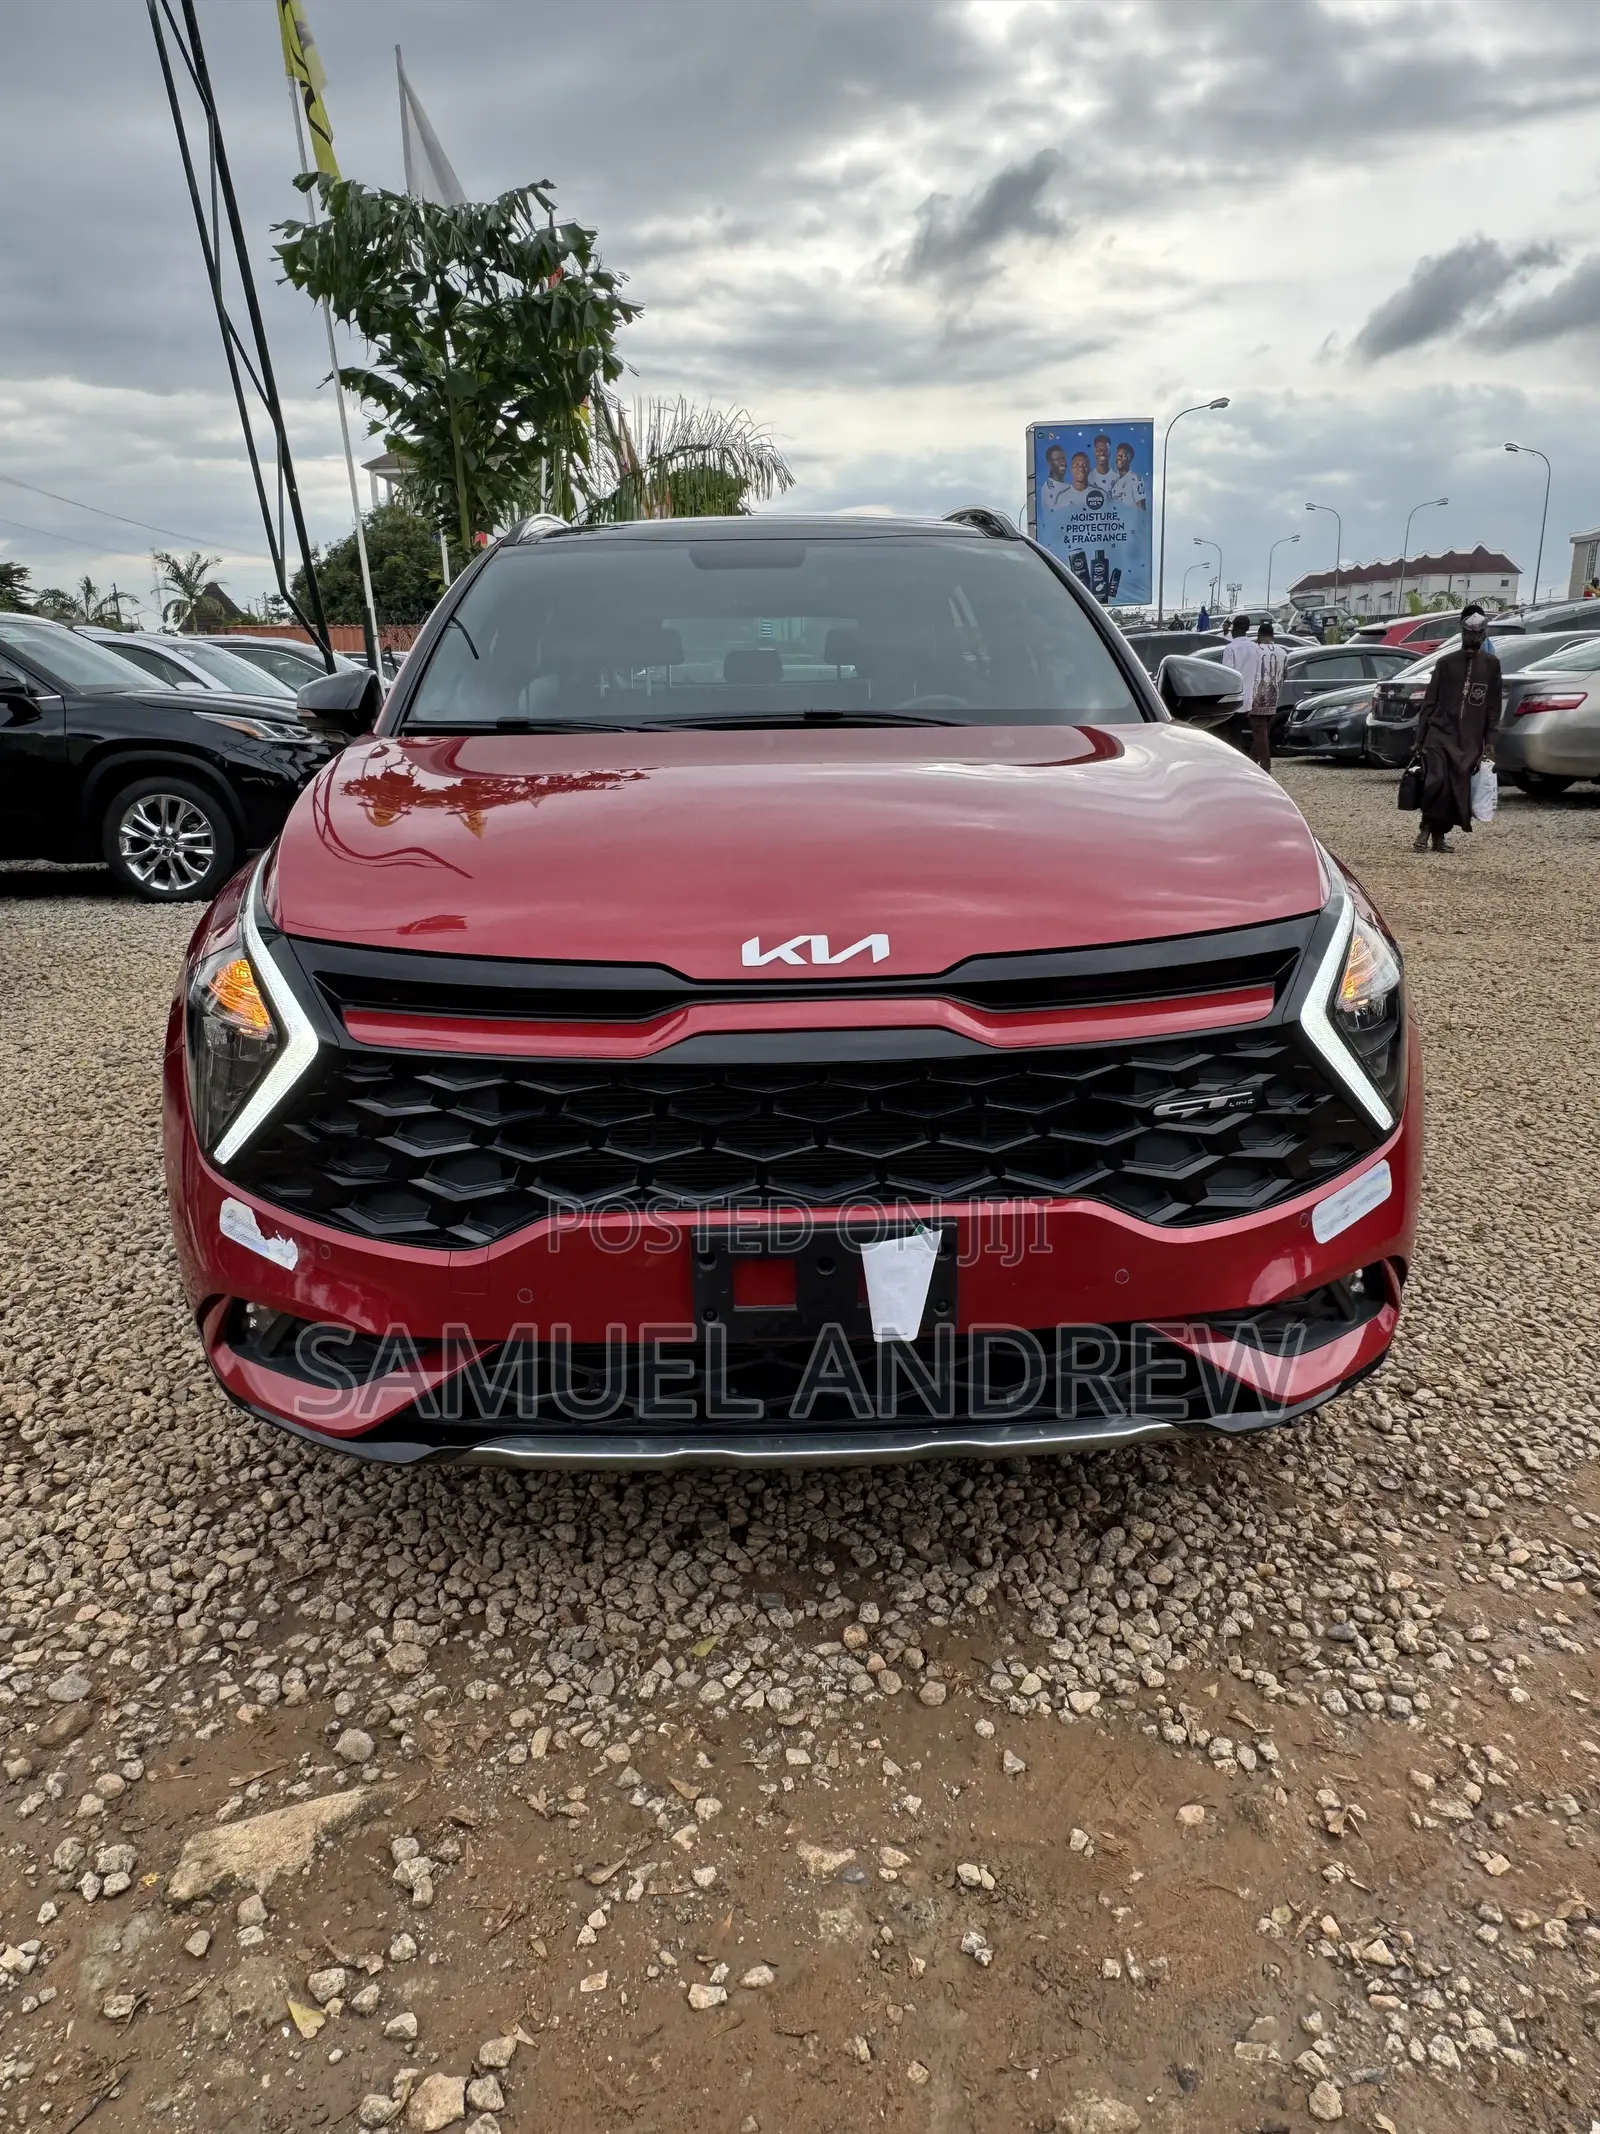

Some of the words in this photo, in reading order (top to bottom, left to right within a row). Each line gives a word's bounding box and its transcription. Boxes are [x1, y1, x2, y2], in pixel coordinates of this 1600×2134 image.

[1070, 512, 1121, 522] MOISTURE,
[1066, 523, 1125, 533] PROTECTION
[1063, 535, 1071, 544] &
[1072, 533, 1127, 543] FRAGRANCE
